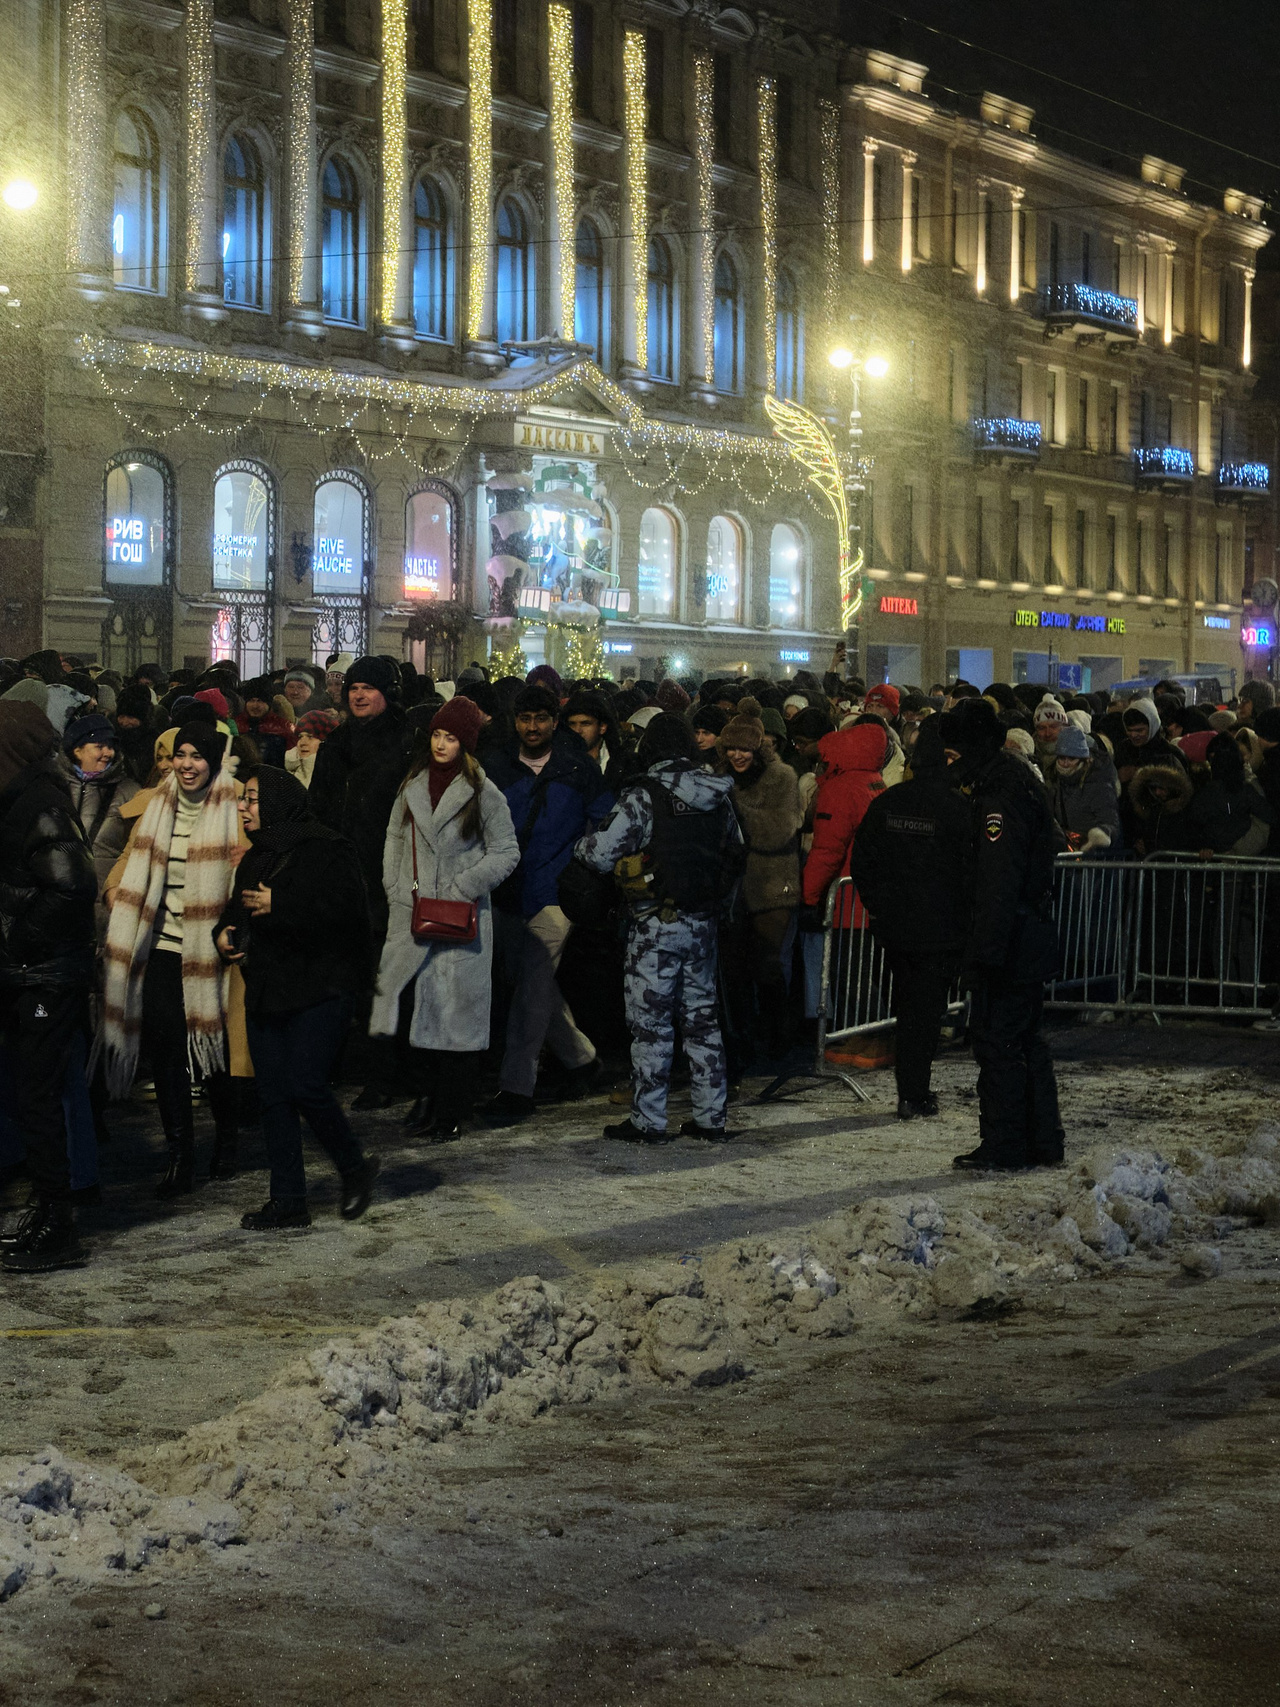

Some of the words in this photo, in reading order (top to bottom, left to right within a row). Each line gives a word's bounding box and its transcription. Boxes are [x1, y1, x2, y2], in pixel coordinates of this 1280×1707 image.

[520, 424, 600, 454] ПАССАЖЪ
[113, 518, 143, 540] РИВ
[214, 533, 258, 547] РФЮМЕРИЯ
[319, 537, 345, 555] RIVE
[112, 542, 143, 563] ГОШ
[214, 546, 254, 558] ОСМЕТИКА
[405, 557, 438, 577] ЧАСТЬЕ
[880, 596, 918, 615] АПТЕКА
[1015, 609, 1038, 628] ОТЕЛЬ
